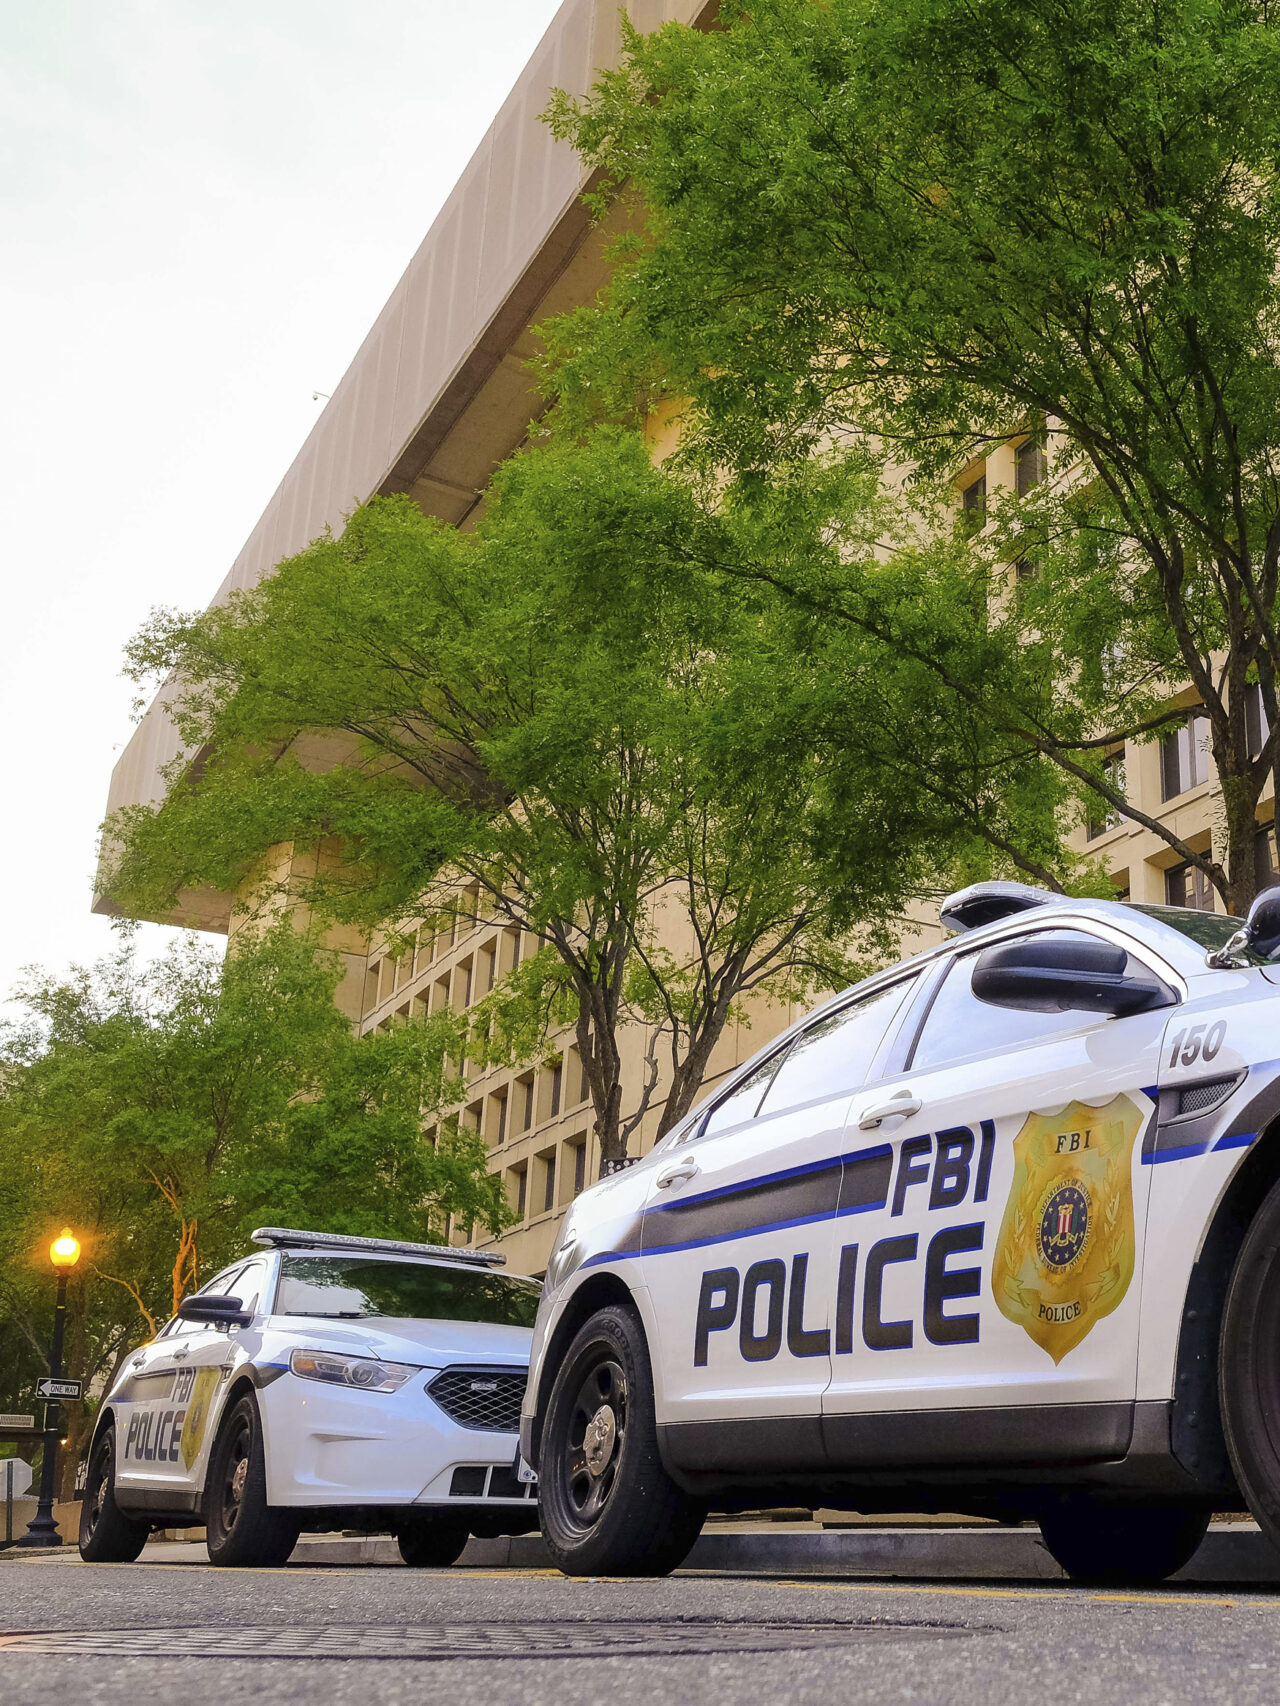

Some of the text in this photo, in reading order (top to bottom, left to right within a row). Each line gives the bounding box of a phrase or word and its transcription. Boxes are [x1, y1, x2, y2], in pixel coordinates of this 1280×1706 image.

[1169, 1020, 1227, 1068] 150
[1054, 1130, 1092, 1154] FBI
[891, 1118, 996, 1217] FBI
[694, 1221, 986, 1367] POLICE
[1038, 1301, 1081, 1322] POLICE
[50, 1384, 78, 1394] ONE WAY
[171, 1367, 197, 1403] FBI
[124, 1410, 186, 1462] POLICE
